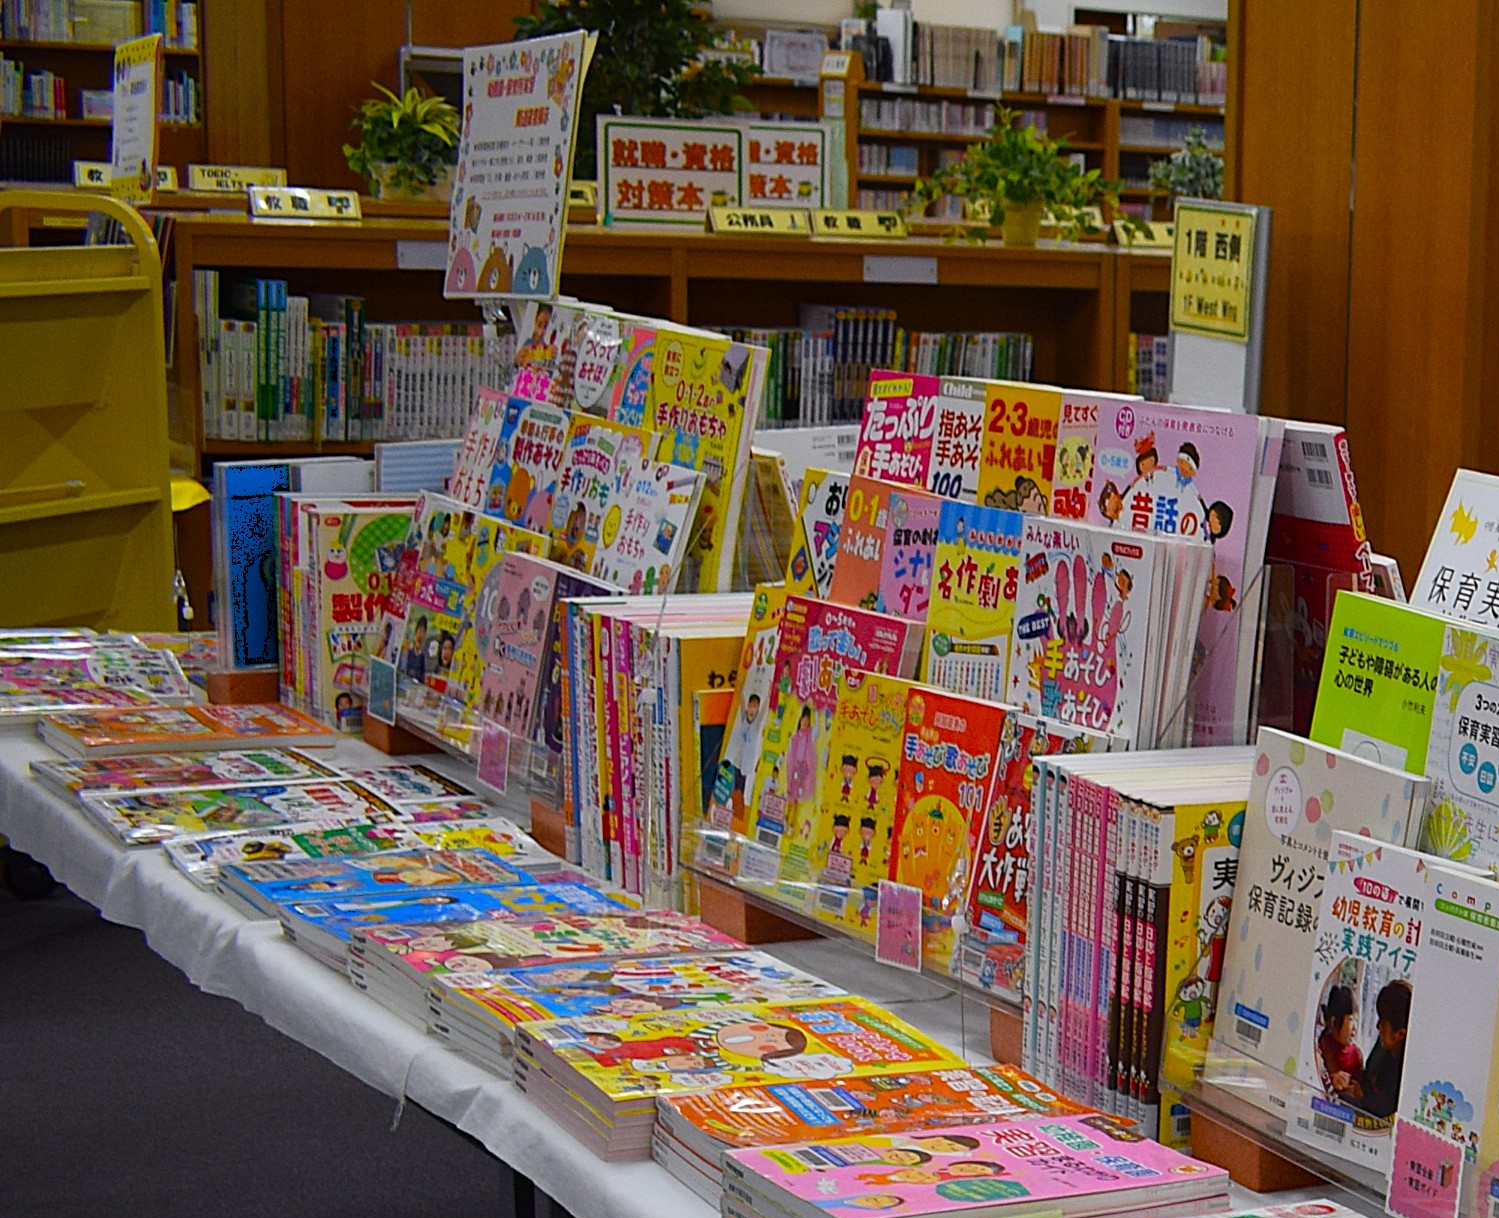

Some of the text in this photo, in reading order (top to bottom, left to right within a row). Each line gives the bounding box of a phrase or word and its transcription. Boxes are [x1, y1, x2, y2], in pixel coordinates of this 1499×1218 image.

[942, 380, 974, 397] Child
[656, 402, 727, 439] 手作りおもちゃ
[932, 471, 961, 498] 100
[1130, 491, 1198, 537] 昔話の
[1026, 524, 1080, 550] みんな楽しい
[1018, 618, 1051, 638] THE BEST
[1044, 639, 1112, 687] 手あそび
[1334, 670, 1374, 698] 心の世界
[1041, 679, 1108, 729] 歌あそび
[958, 781, 983, 812] 101
